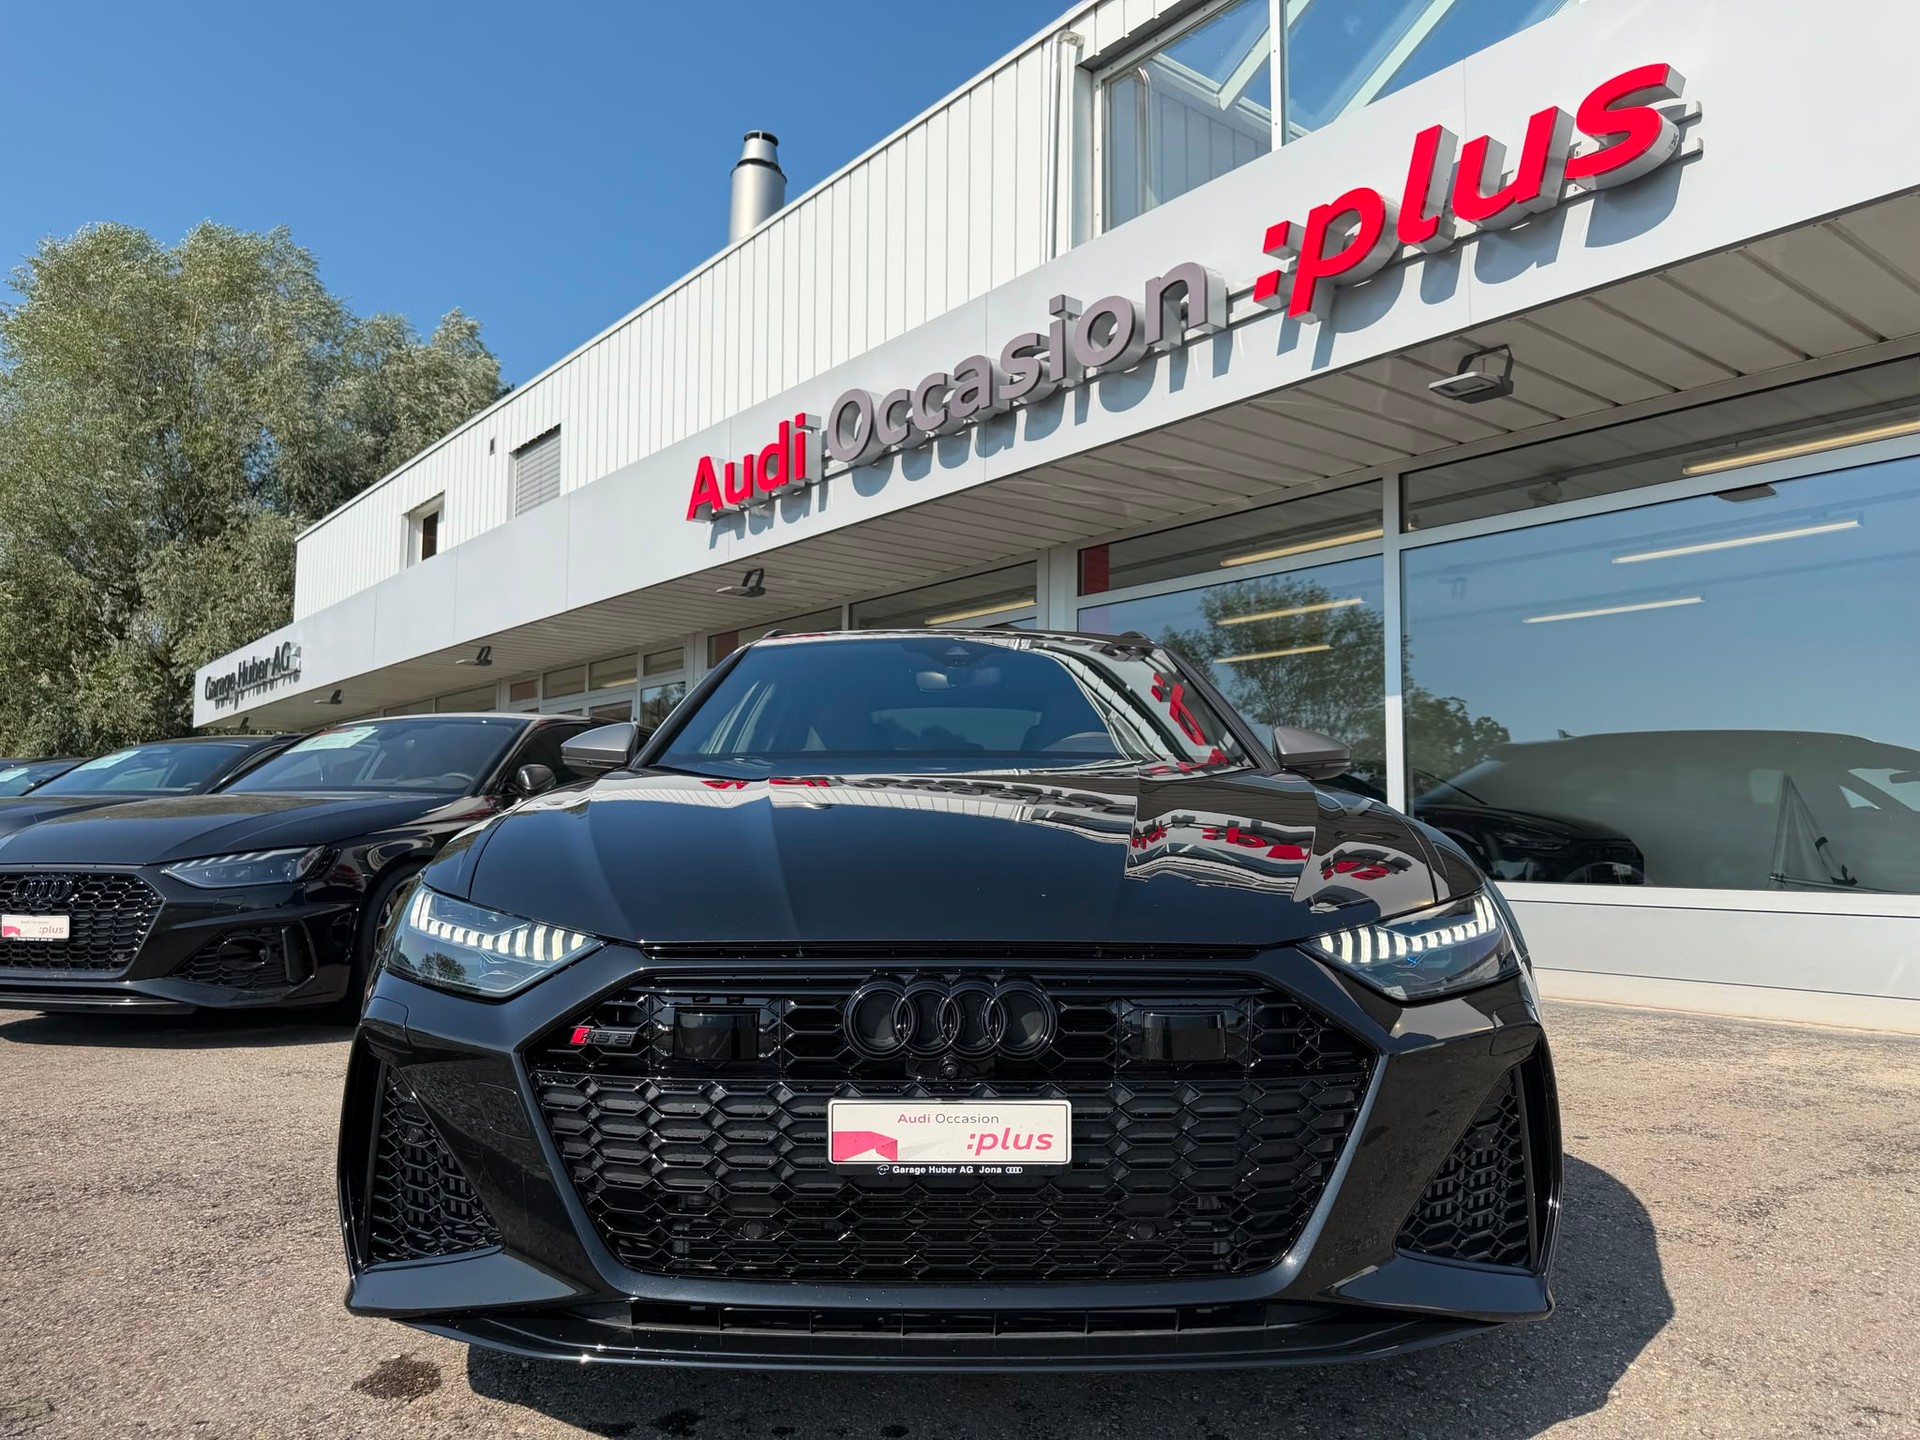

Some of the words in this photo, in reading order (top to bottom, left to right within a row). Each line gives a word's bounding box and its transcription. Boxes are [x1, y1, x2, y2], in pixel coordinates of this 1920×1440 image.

[686, 411, 807, 521] Audi
[826, 261, 1209, 463] Occasion
[1253, 63, 1671, 319] :plus
[205, 672, 237, 701] Garage
[237, 656, 272, 688] Huber
[272, 641, 291, 676] AG
[897, 1113, 931, 1124] Audi
[935, 1113, 1000, 1124] Occasion
[966, 1127, 1054, 1157] :plus
[892, 1165, 926, 1176] Garage
[928, 1165, 957, 1174] Huber
[959, 1165, 974, 1174] AG
[978, 1165, 1002, 1174] Jona
